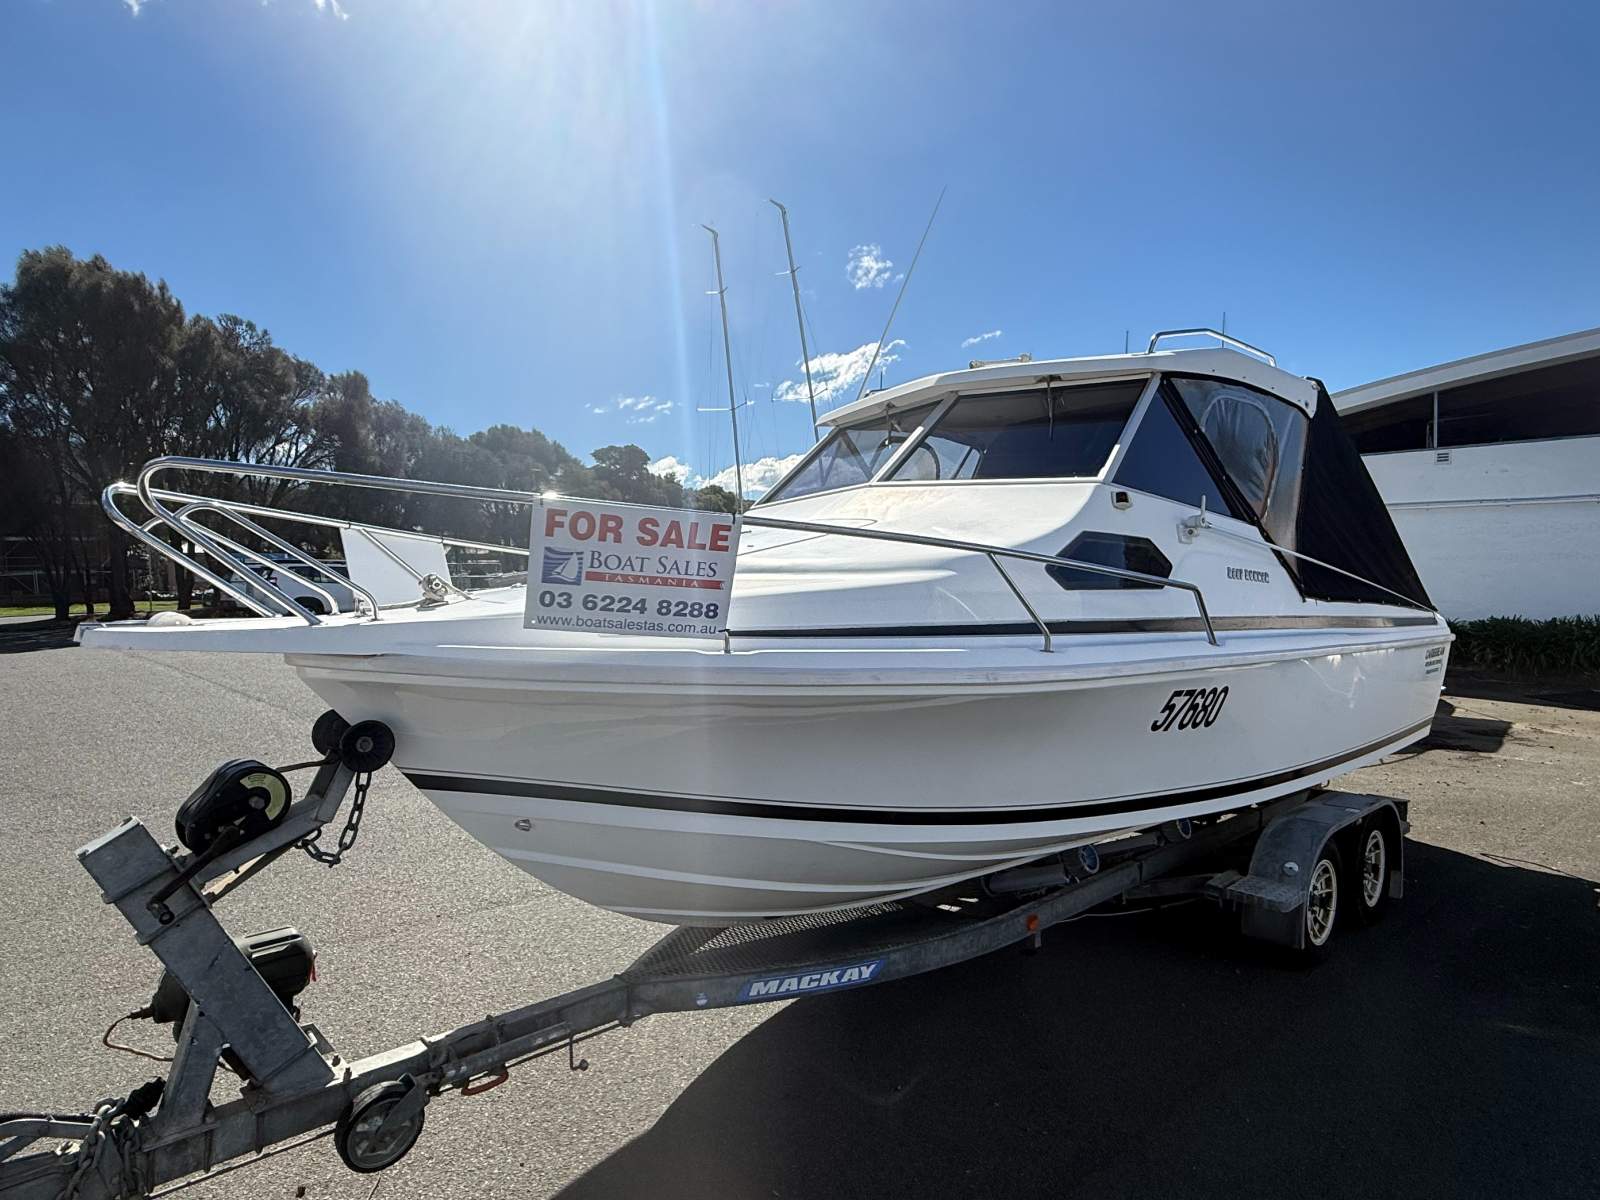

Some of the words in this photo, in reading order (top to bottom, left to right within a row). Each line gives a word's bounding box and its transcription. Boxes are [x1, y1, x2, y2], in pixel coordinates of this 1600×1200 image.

[544, 508, 624, 544] FOR
[636, 517, 732, 552] SALE
[589, 550, 650, 573] BOAT
[656, 555, 718, 577] SALES
[604, 574, 700, 588] TASMANIA
[538, 590, 573, 609] 03
[582, 594, 648, 615] 6224
[656, 599, 720, 619] 8288
[536, 614, 717, 634] www.boatsalestas.com.au
[1151, 685, 1229, 732] 57680
[749, 964, 877, 996] MACKAY
